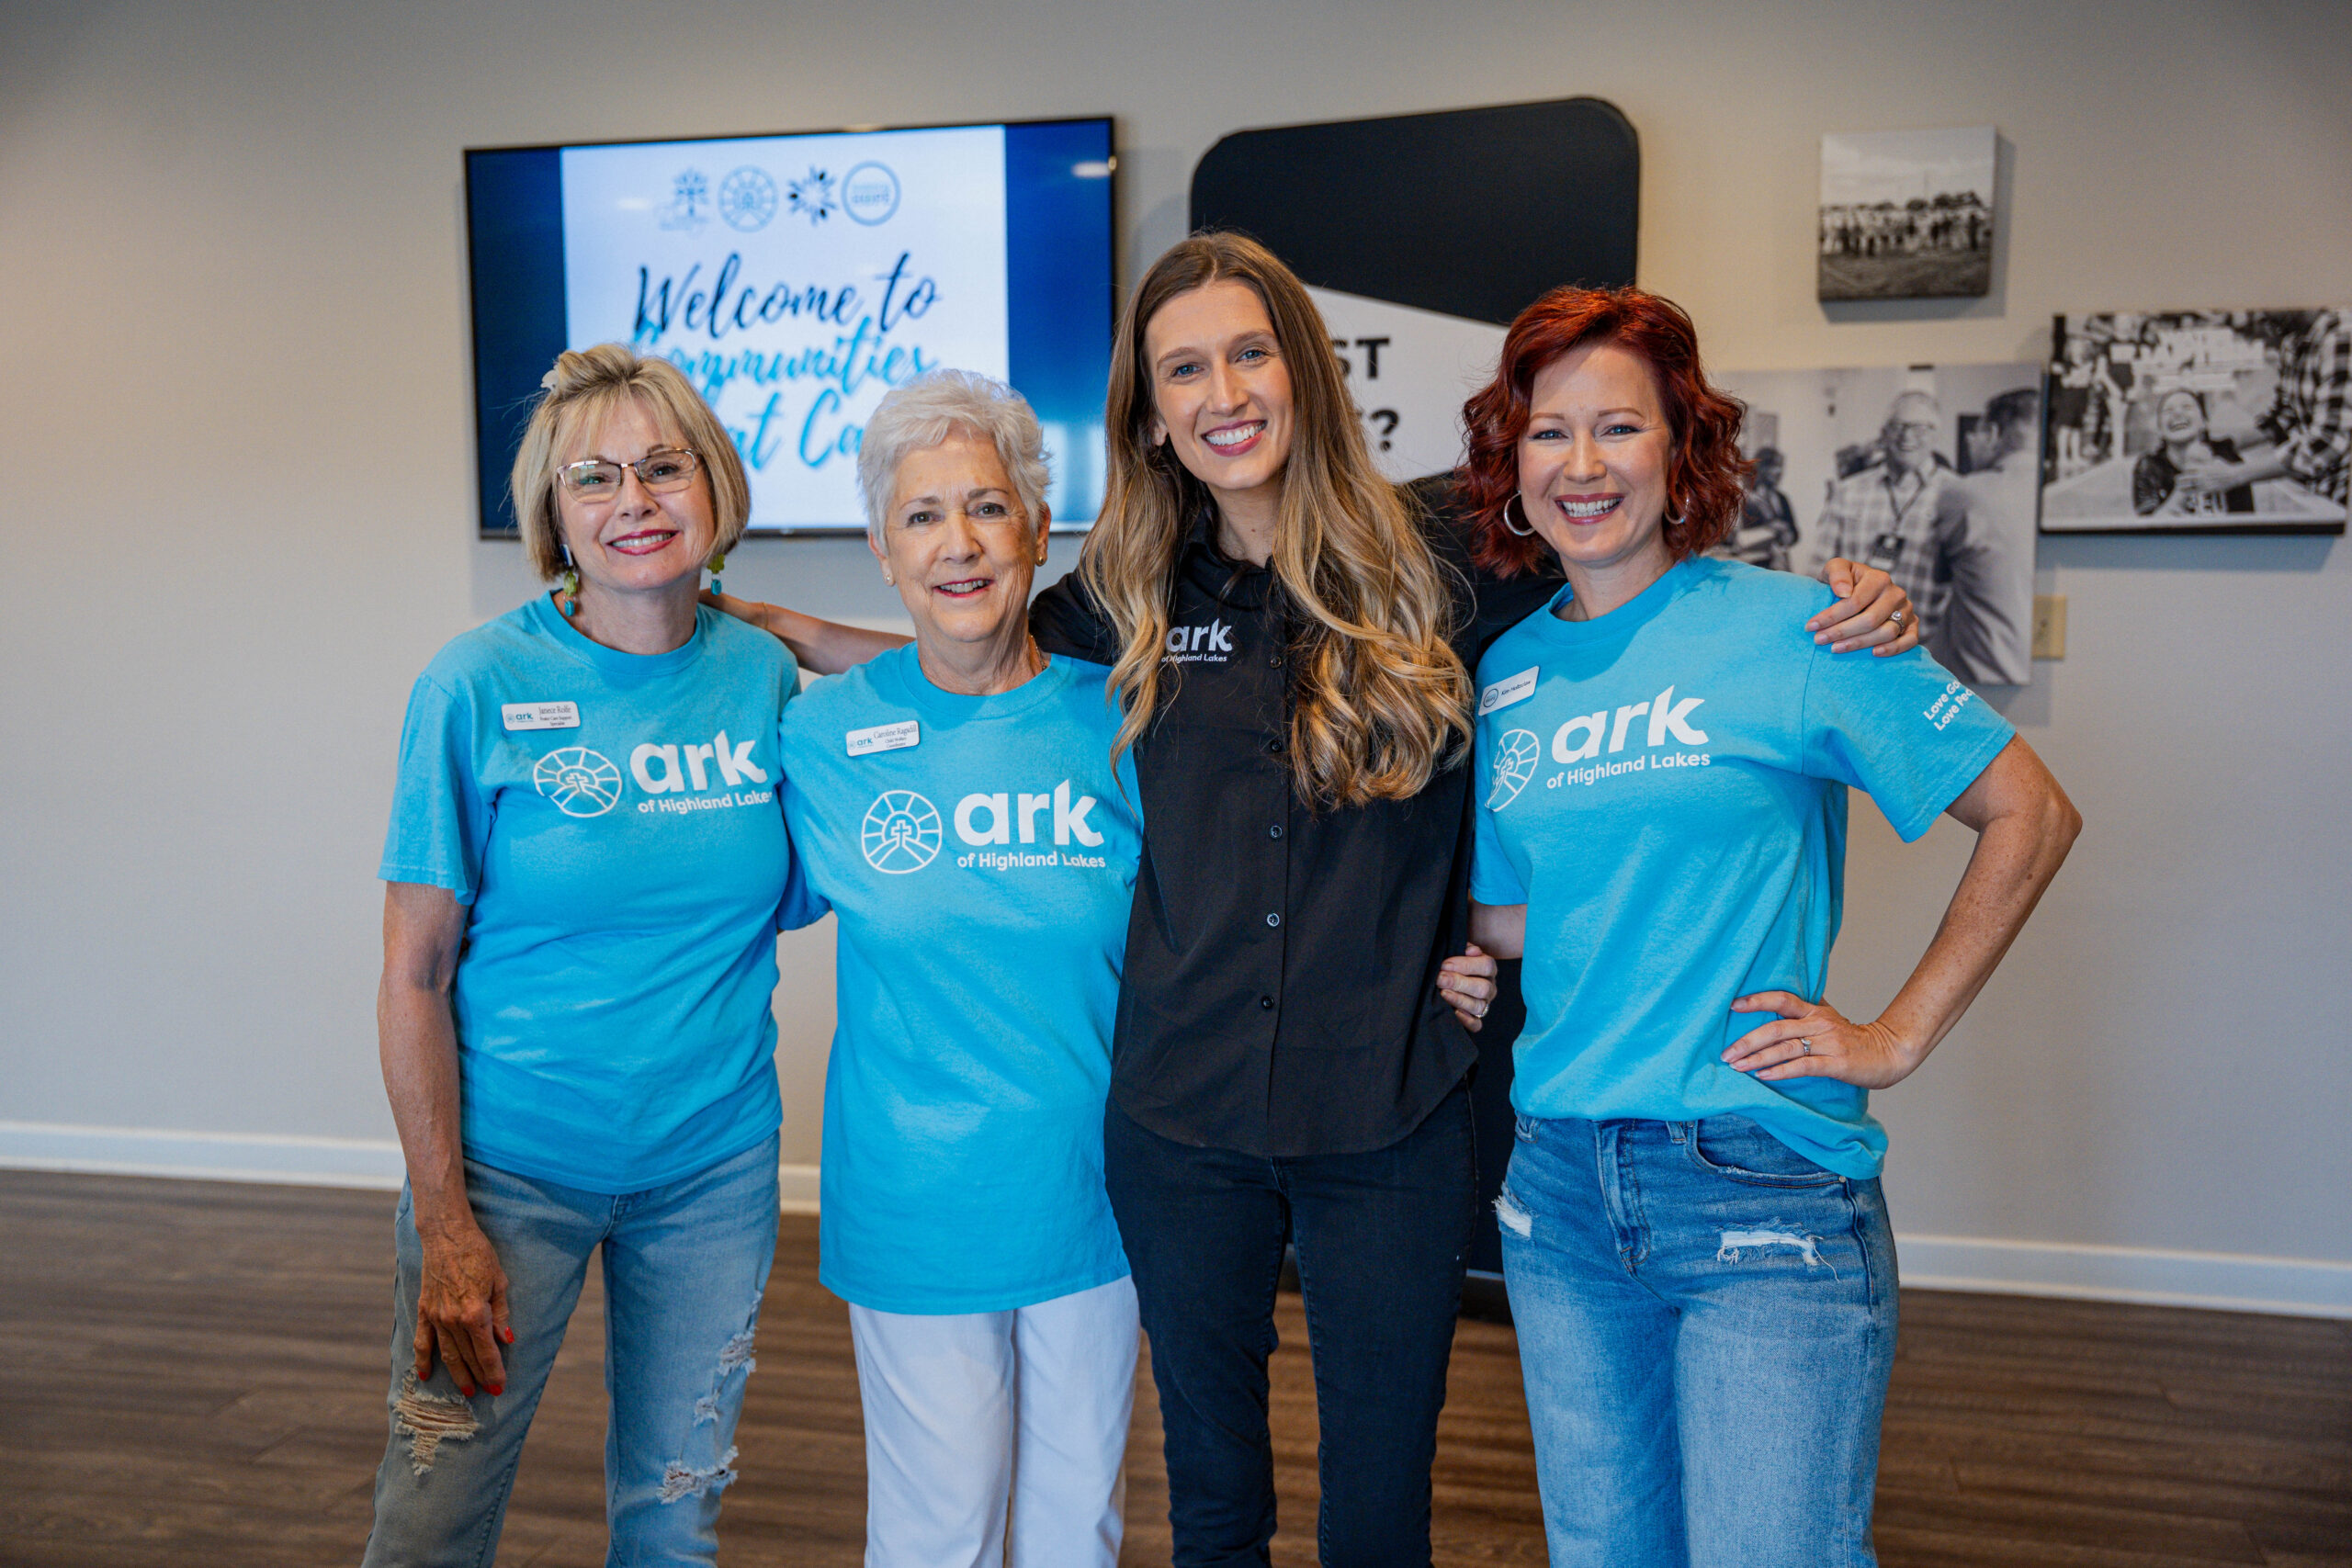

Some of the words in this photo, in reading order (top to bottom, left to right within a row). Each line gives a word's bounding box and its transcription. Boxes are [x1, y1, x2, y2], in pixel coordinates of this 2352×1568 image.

[635, 252, 864, 339] Welcome
[874, 251, 940, 333] to
[633, 316, 939, 395] ommunities
[798, 388, 864, 468] Ca
[1165, 617, 1233, 652] ark
[1204, 653, 1227, 662] Lakes
[1922, 694, 1949, 721] Love
[1946, 680, 1962, 694] Go
[1933, 705, 1960, 731] Love
[1954, 688, 1975, 706] Peo
[856, 737, 873, 746] ark
[1552, 684, 1709, 764] ark
[629, 729, 768, 794] ark
[1546, 772, 1565, 789] of
[1566, 755, 1645, 786] Highland
[1651, 751, 1711, 769] Lakes
[638, 799, 655, 813] of
[658, 793, 733, 815] Highland
[954, 778, 1104, 847] ark
[957, 853, 976, 867] of
[978, 851, 1057, 871] Highland
[1063, 852, 1106, 868] Lakes
